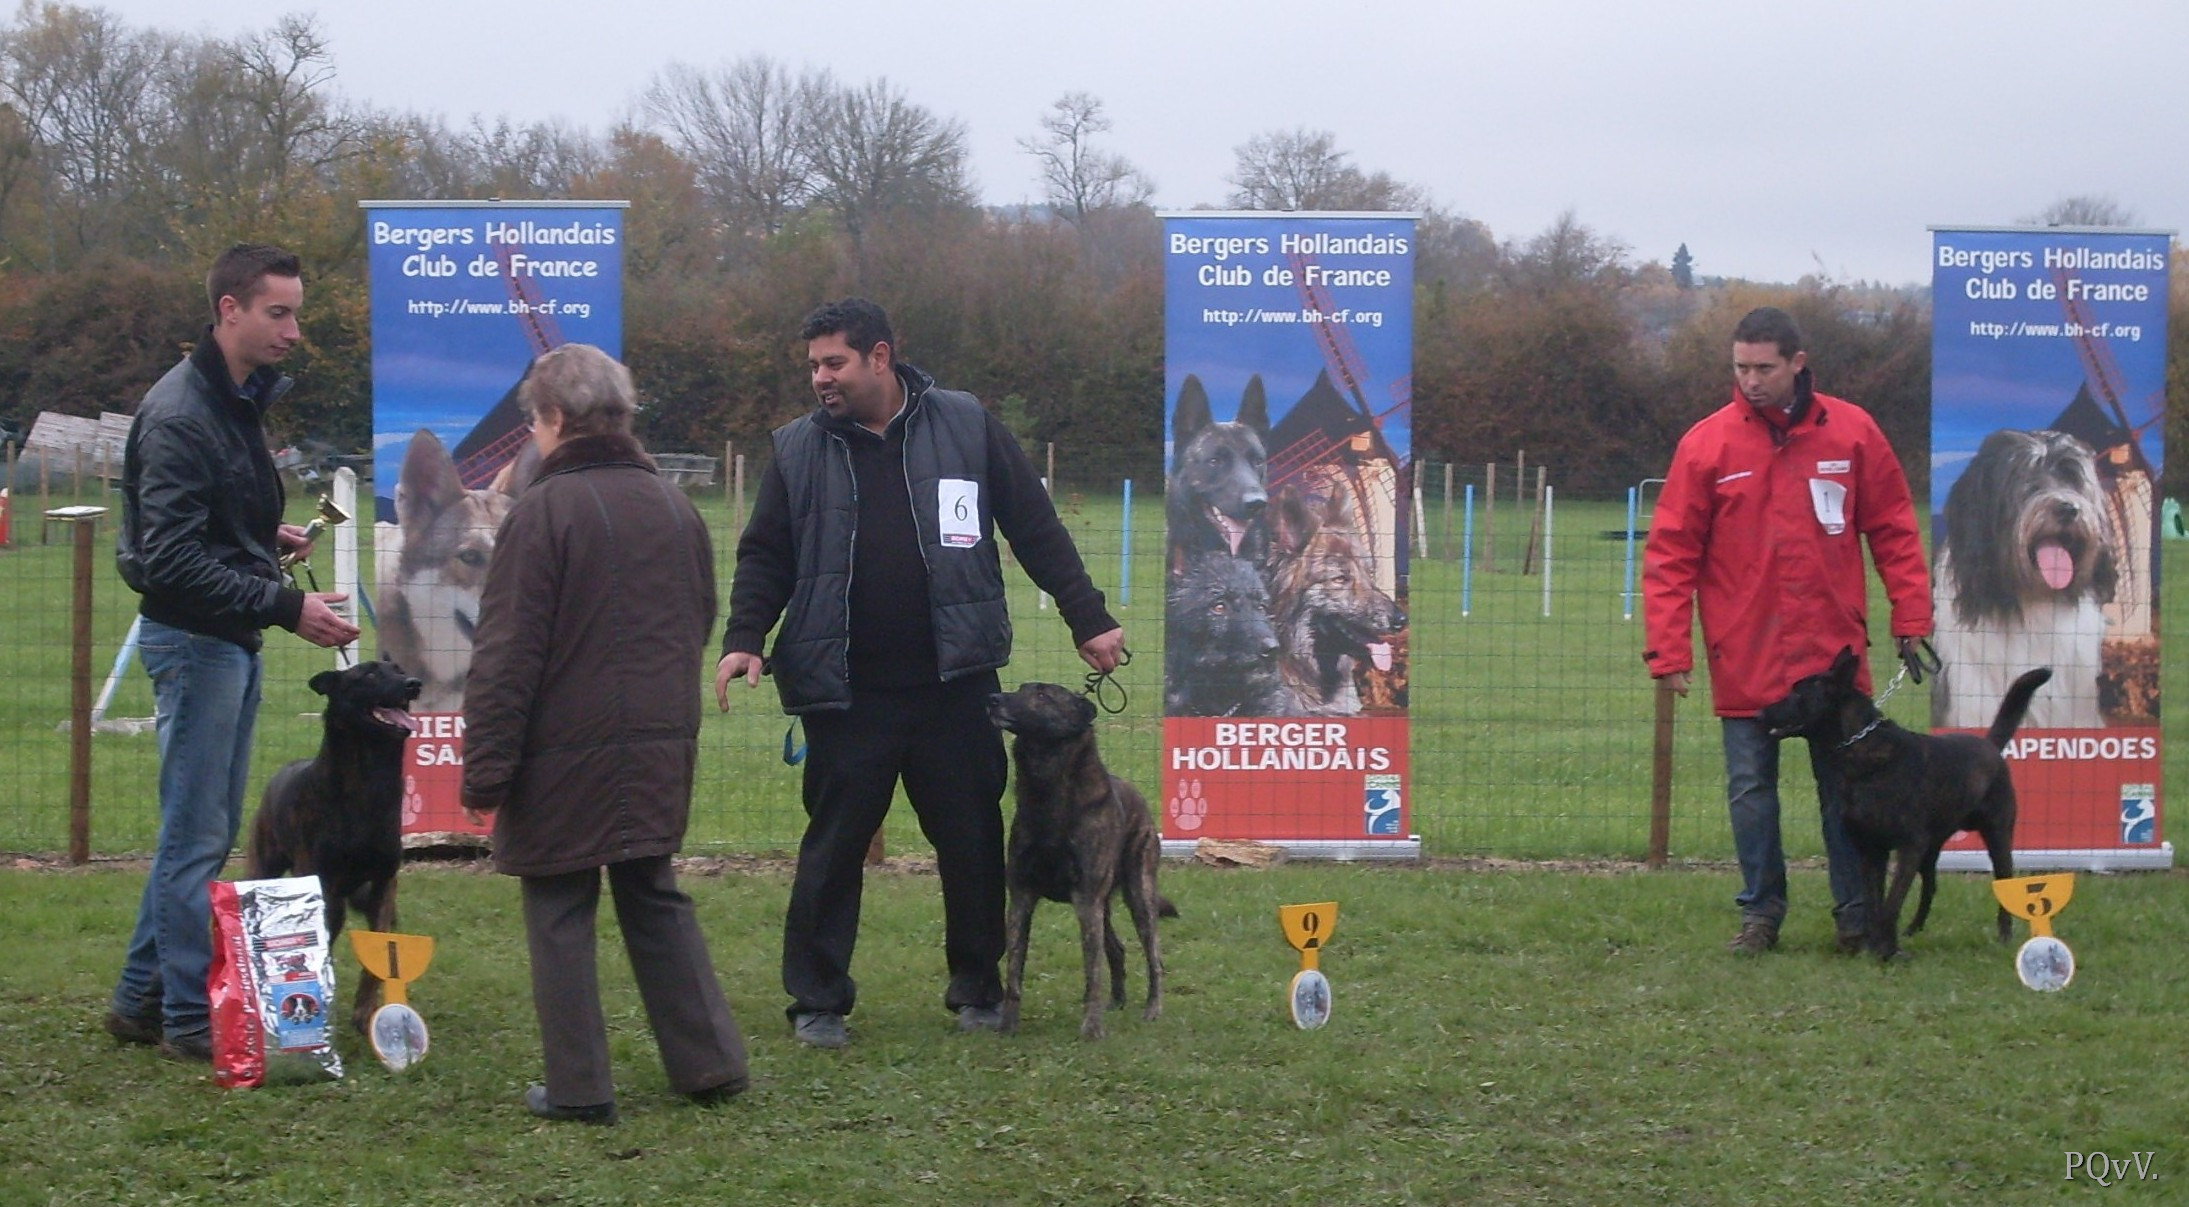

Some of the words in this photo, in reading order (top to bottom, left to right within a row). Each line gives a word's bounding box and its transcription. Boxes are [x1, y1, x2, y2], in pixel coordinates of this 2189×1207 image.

[373, 221, 474, 250] Bergers
[485, 221, 616, 245] Hollandais
[1170, 233, 1270, 260] Bergers
[1280, 233, 1408, 254] Hollandais
[402, 254, 457, 277] Club
[468, 254, 499, 277] de
[510, 254, 598, 278] France
[1938, 246, 2033, 273] Bergers
[2044, 248, 2165, 270] Hollandais
[1198, 265, 1252, 286] Club
[1263, 265, 1294, 286] de
[1305, 265, 1392, 286] France
[1965, 278, 2017, 299] Club
[2026, 278, 2057, 300] de
[2067, 279, 2149, 301] France
[408, 299, 590, 318] http://www.bh-cf.org
[1203, 309, 1383, 327] http://www.bh-cf.org
[1970, 321, 2141, 342] http://www.bh-cf.org
[954, 495, 968, 522] 6
[1215, 722, 1347, 746] BERGER
[416, 744, 464, 766] SA
[1172, 747, 1390, 771] HOLLANDAIS
[2025, 882, 2053, 916] 3
[387, 940, 400, 979] 1
